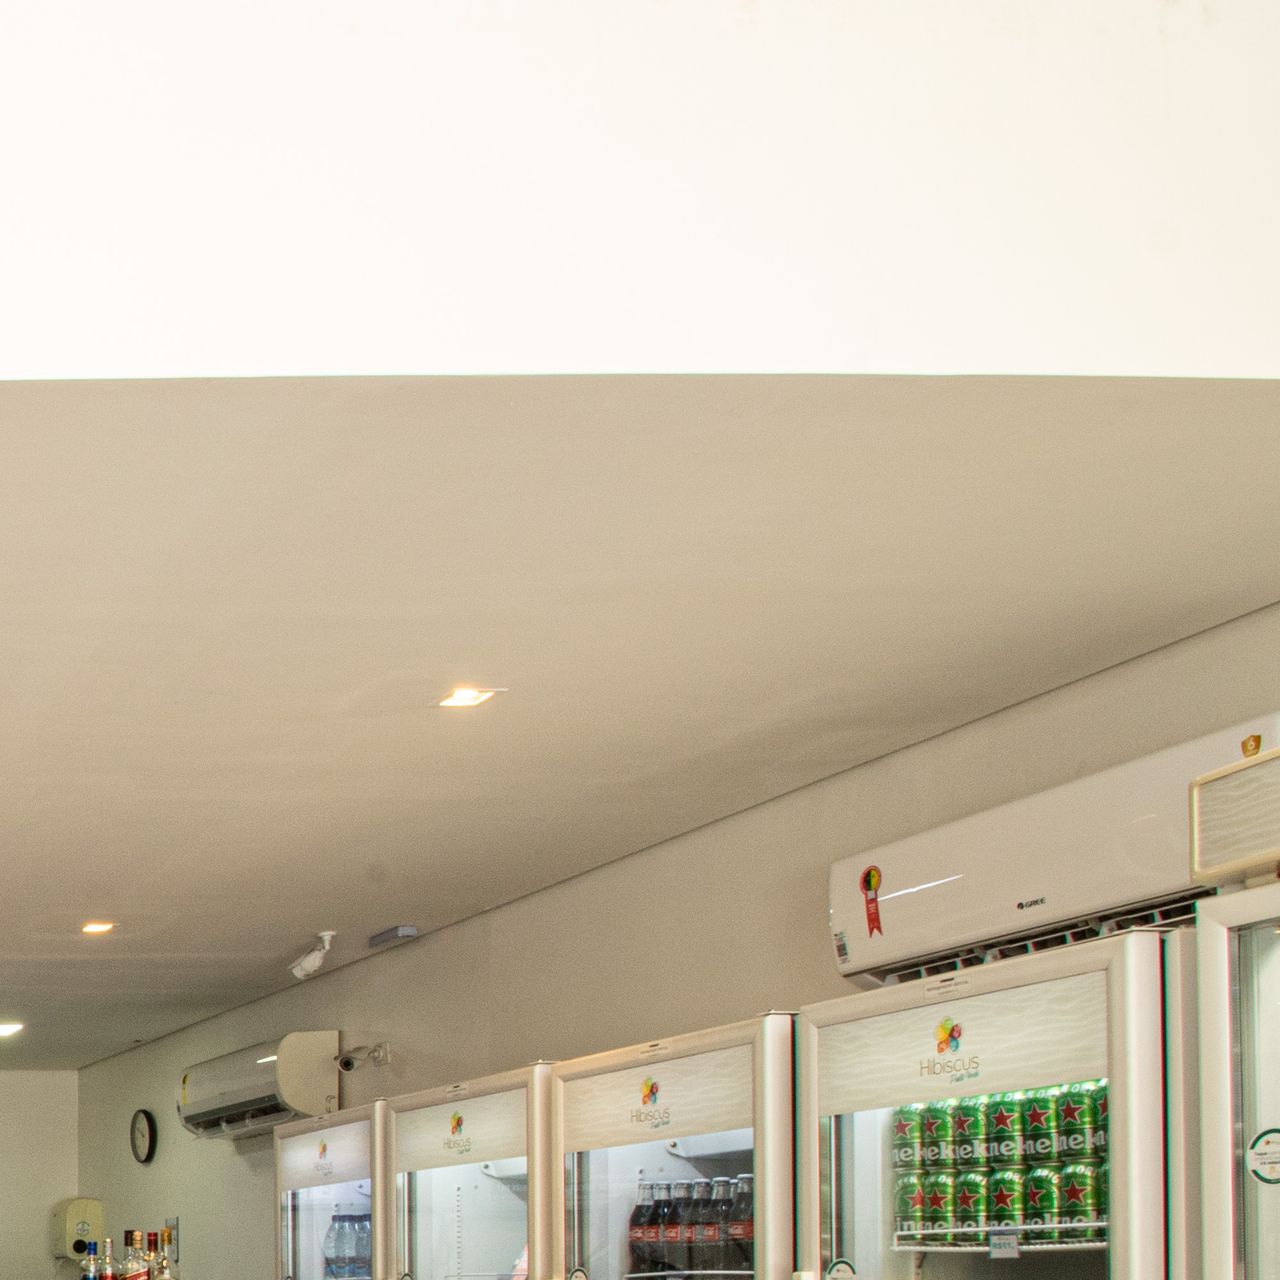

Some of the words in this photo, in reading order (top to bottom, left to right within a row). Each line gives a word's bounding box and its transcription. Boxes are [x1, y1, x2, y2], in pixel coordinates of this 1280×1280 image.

[1025, 897, 1046, 909] GREE
[919, 1056, 980, 1077] Hibiscus
[630, 1107, 671, 1124] Hibiscus
